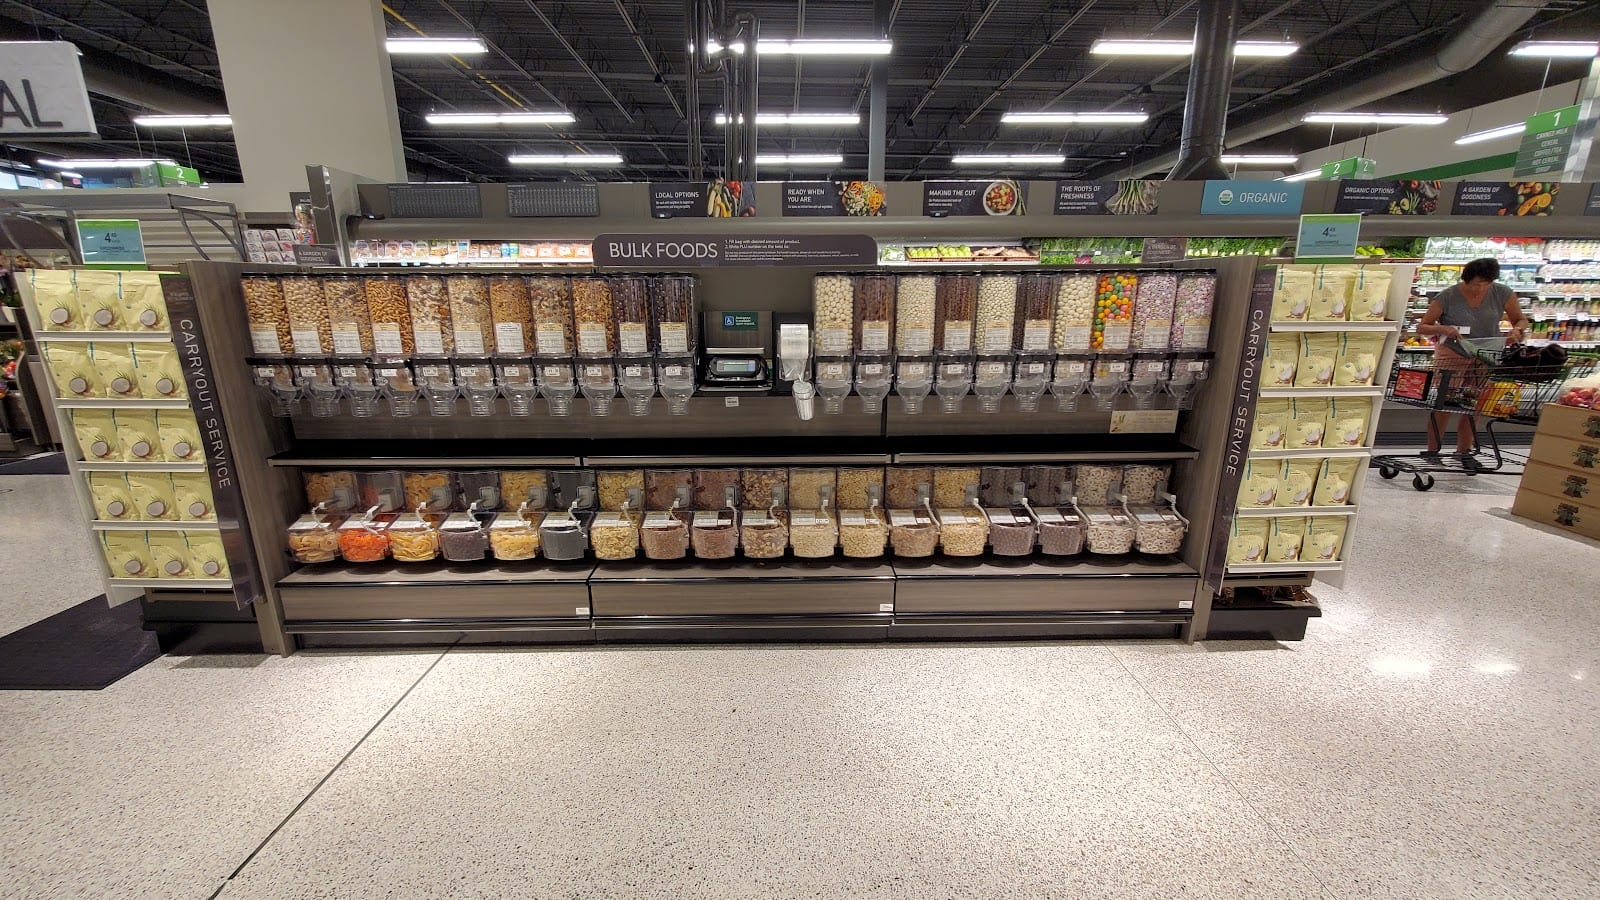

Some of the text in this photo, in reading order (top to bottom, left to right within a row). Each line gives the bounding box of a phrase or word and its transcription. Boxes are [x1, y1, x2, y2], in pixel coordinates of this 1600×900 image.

[1553, 112, 1562, 127] 1
[176, 167, 185, 179] 2
[1332, 163, 1340, 175] 2
[1239, 192, 1289, 203] ORGANIC
[1344, 186, 1370, 194] ORGANIC
[609, 242, 653, 258] BULK
[656, 242, 719, 258] FOODS
[1239, 309, 1264, 402] CARRYOUT
[180, 319, 214, 412] CARRYOUT
[206, 417, 231, 489] SERVICE
[1226, 406, 1248, 477] SERVICE
